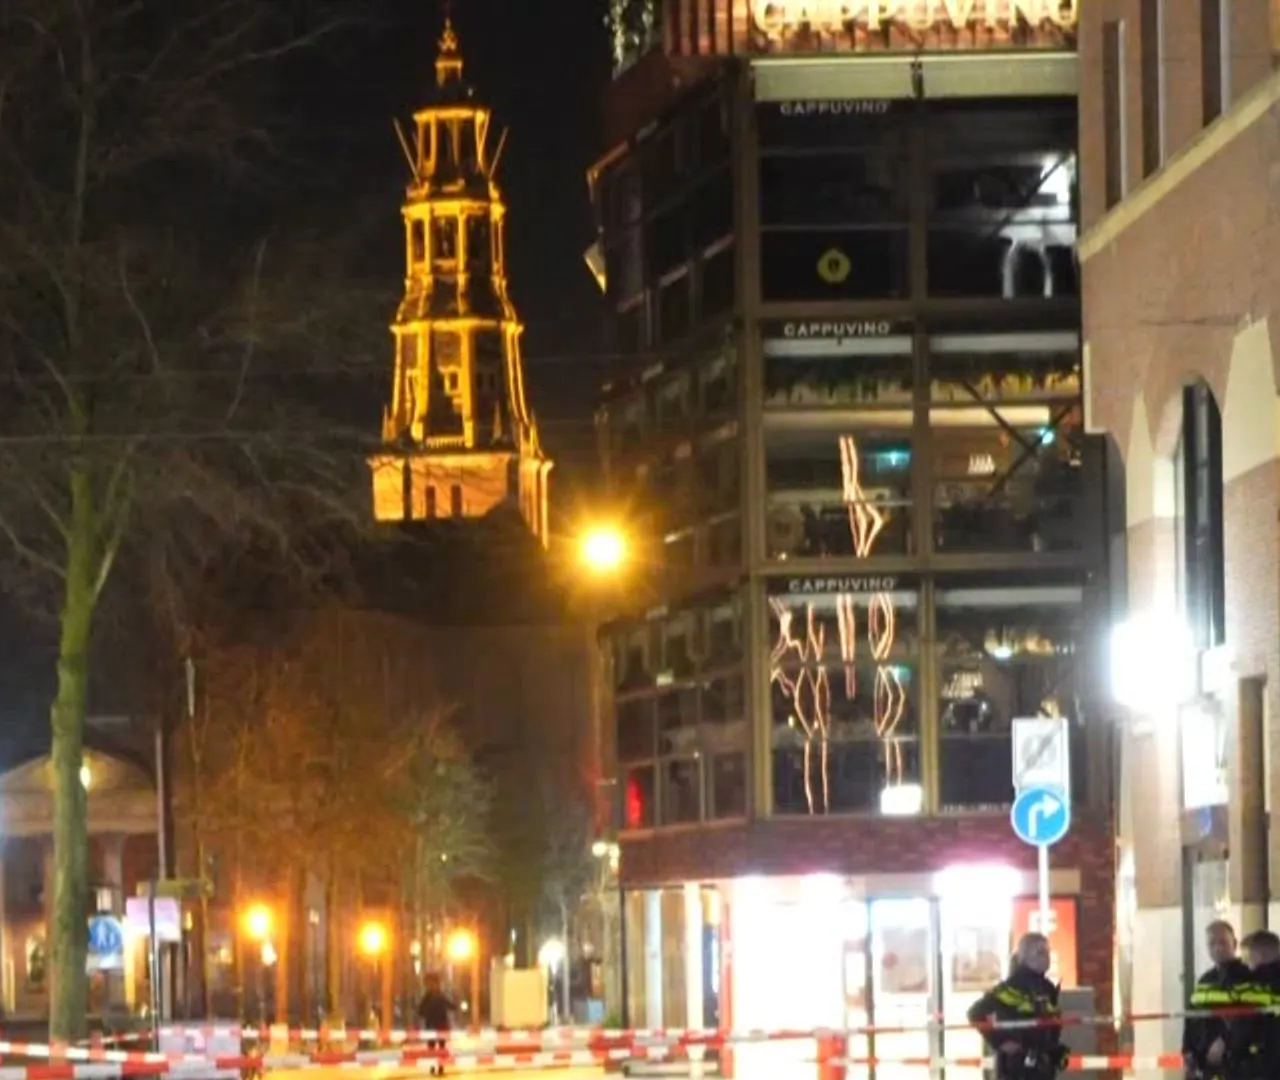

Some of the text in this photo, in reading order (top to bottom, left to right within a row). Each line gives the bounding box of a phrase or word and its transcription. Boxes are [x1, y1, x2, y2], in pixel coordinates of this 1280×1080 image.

[780, 101, 889, 116] CAPPUVINO
[784, 321, 890, 337] CAPPUVINO
[788, 577, 895, 593] CAPPUVINO
